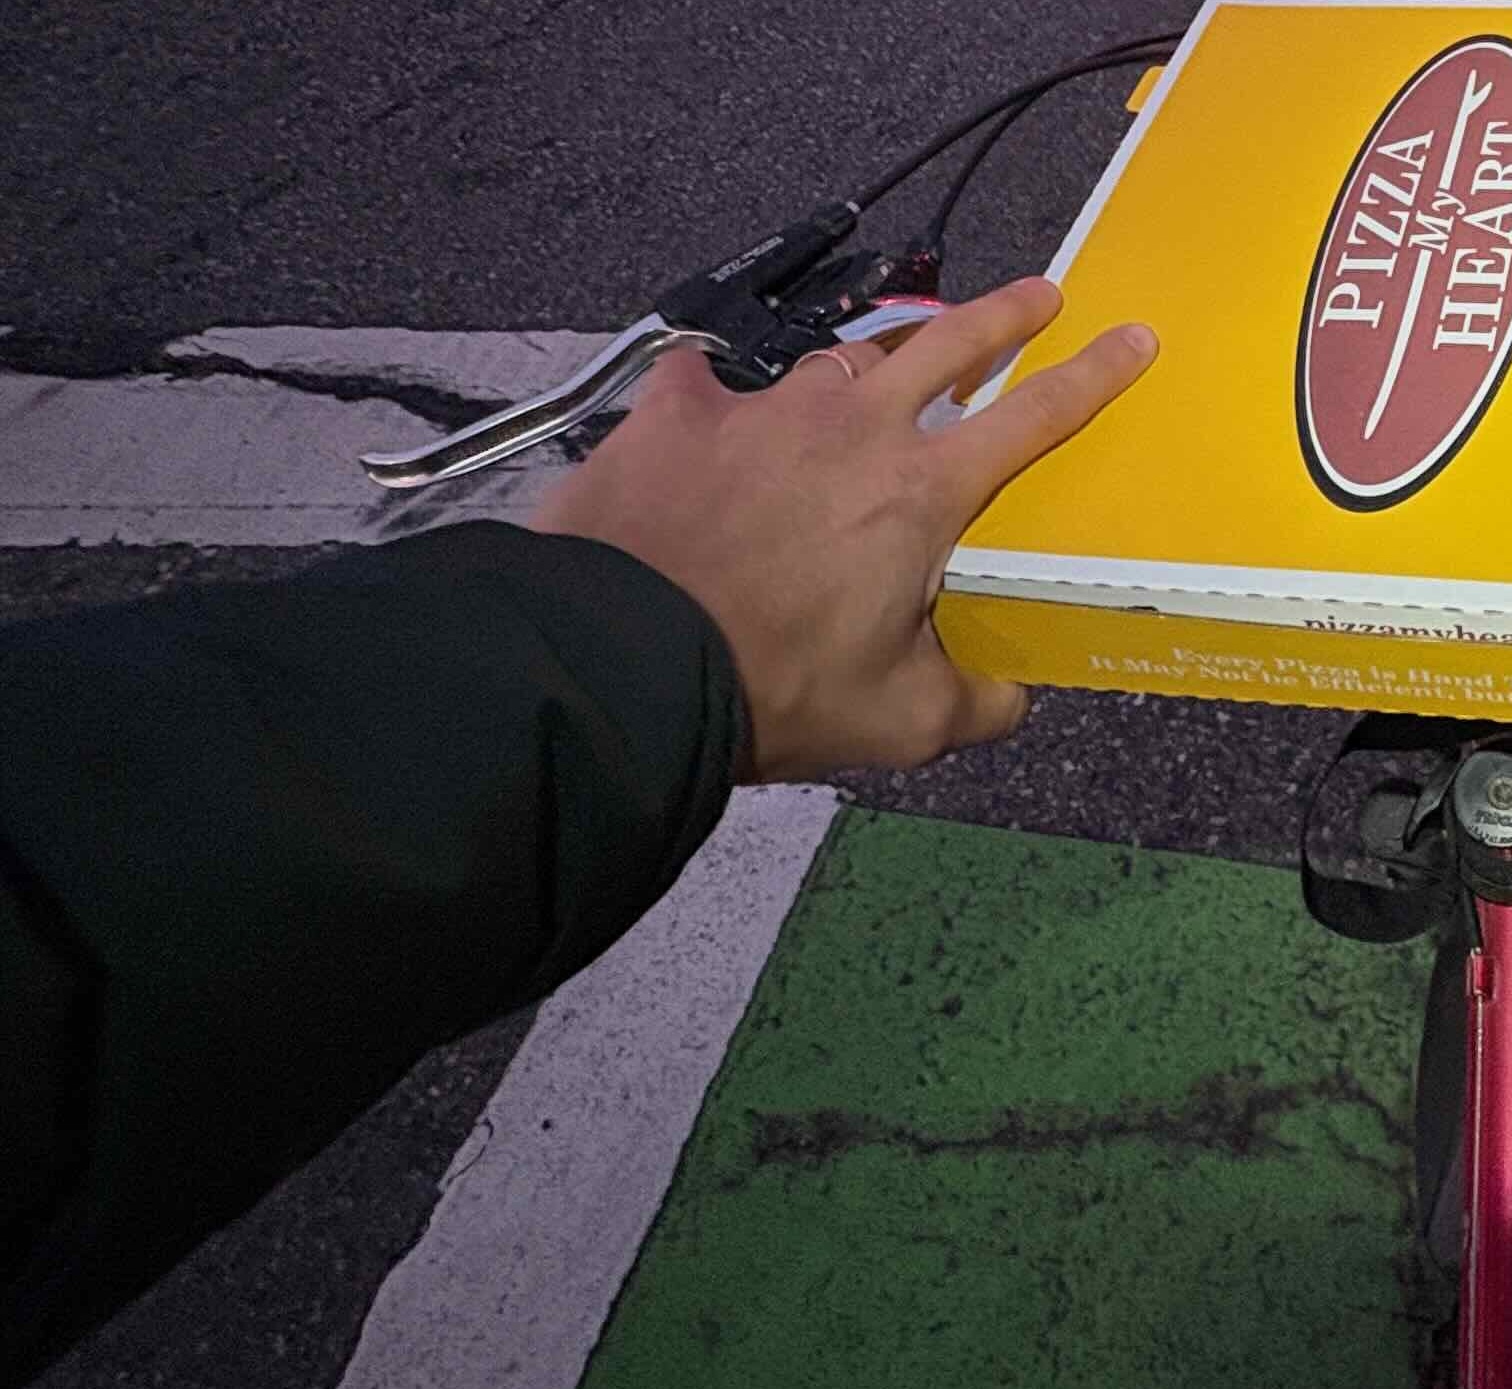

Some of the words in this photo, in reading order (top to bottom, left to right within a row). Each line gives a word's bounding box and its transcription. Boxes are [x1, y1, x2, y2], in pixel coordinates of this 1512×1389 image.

[1319, 129, 1434, 328] PIZZA
[1408, 188, 1466, 255] My
[1088, 654, 1119, 672] It
[1123, 658, 1186, 679] May
[1199, 666, 1252, 684] Not
[1263, 671, 1300, 688] be
[1171, 647, 1263, 671] Every
[1275, 657, 1361, 681] Pizza
[1407, 668, 1494, 689] Hand
